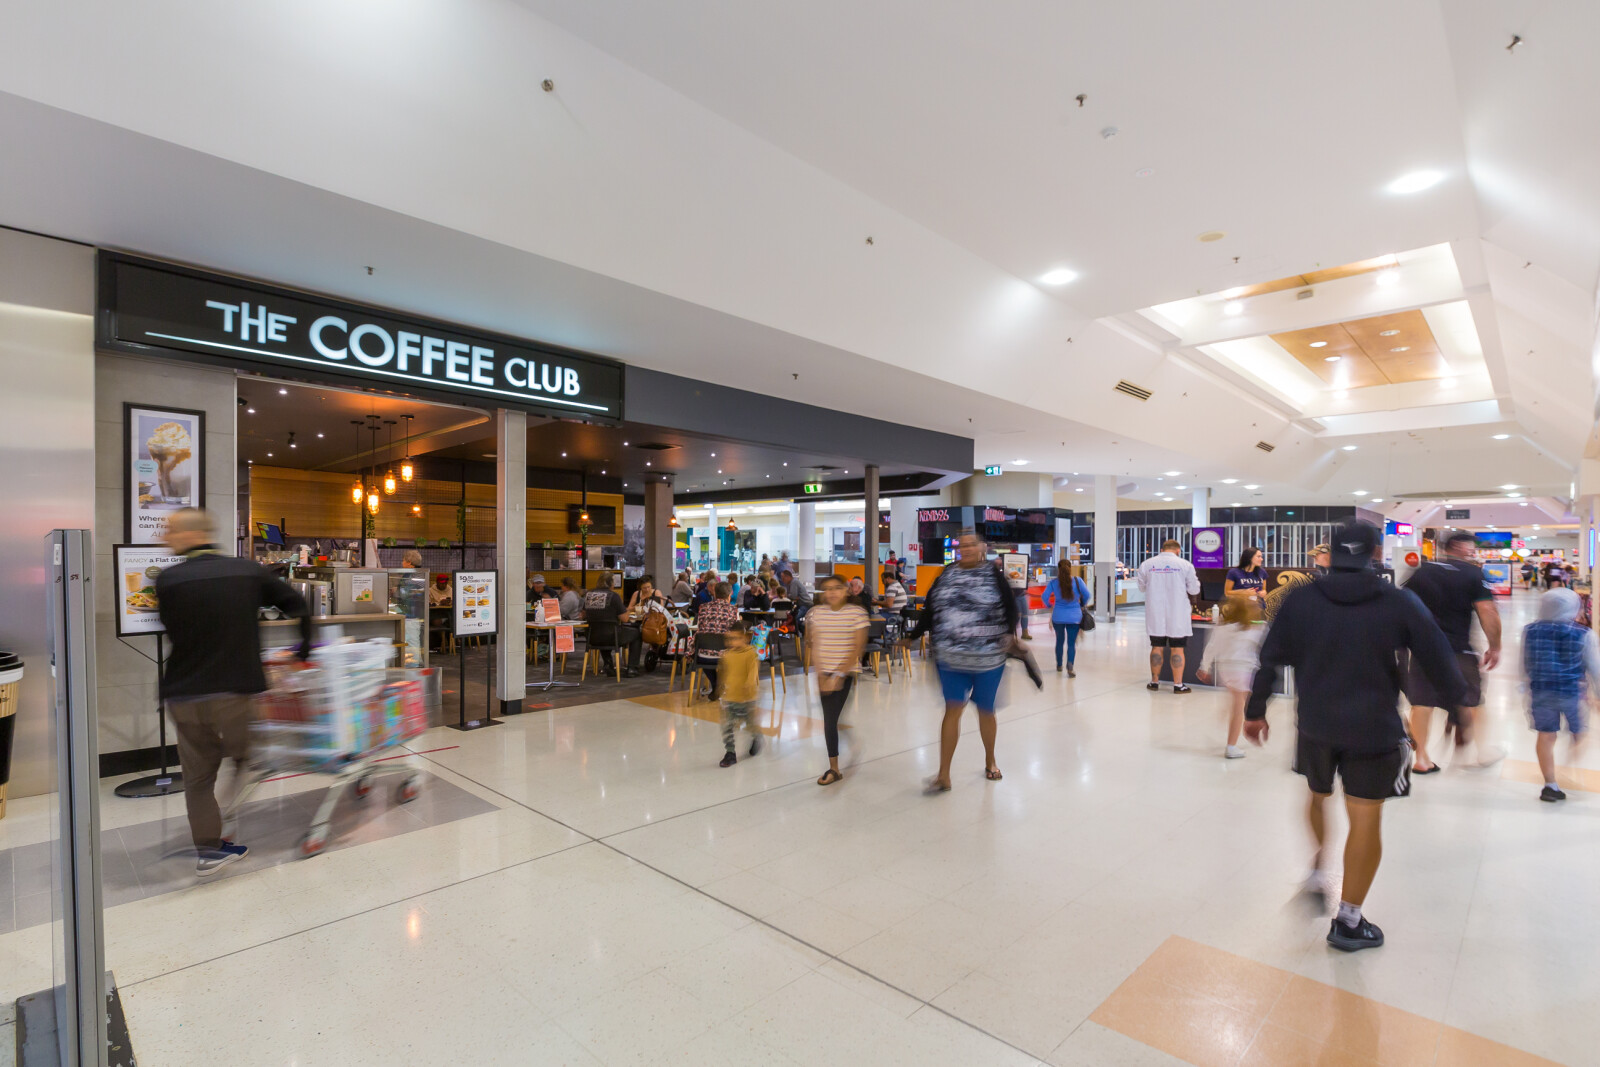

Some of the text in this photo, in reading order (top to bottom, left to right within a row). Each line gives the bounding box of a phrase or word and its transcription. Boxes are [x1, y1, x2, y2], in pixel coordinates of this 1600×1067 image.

[206, 300, 581, 396] THE COFFEE CLUB
